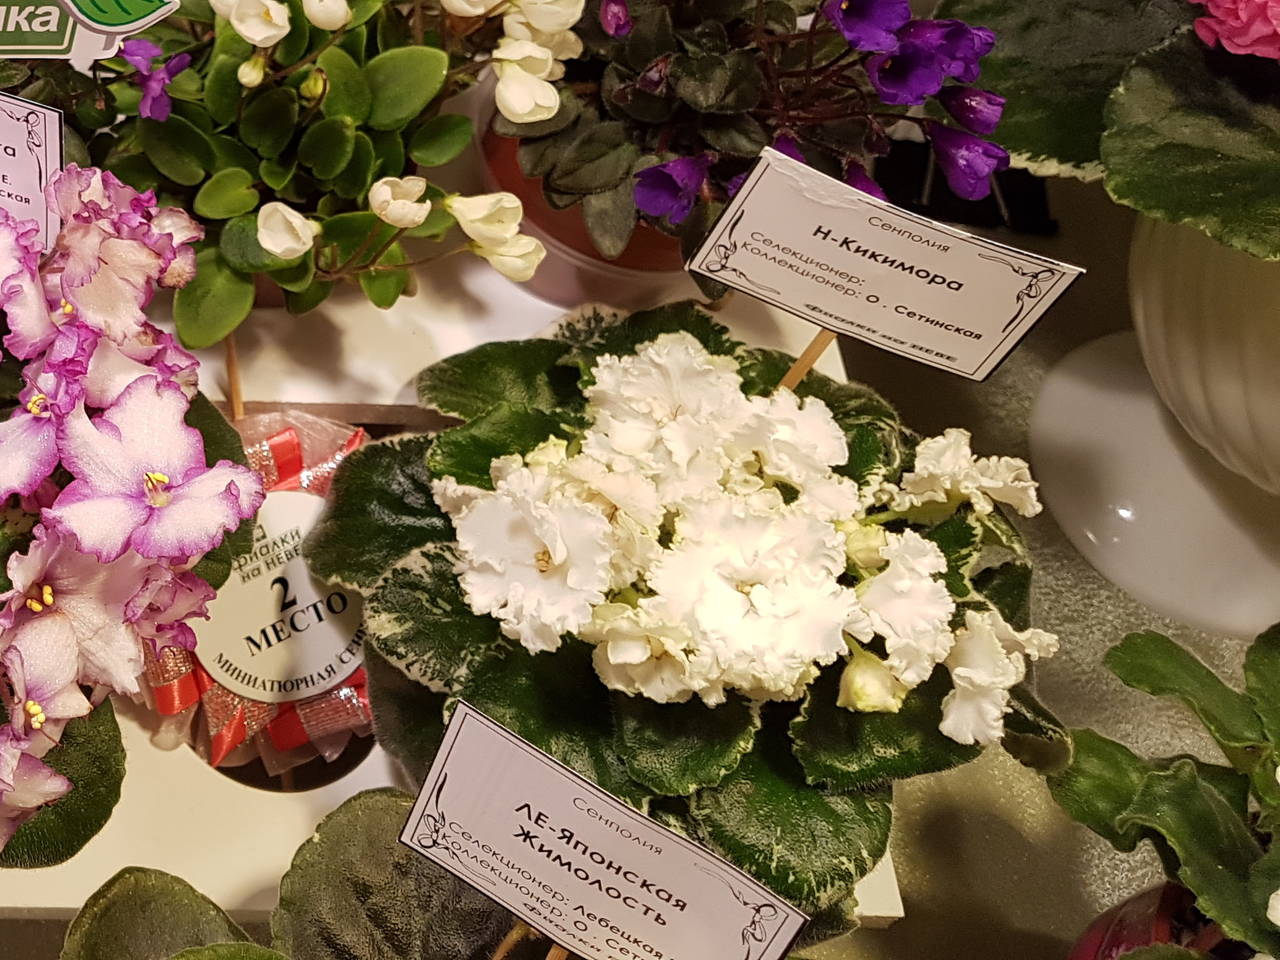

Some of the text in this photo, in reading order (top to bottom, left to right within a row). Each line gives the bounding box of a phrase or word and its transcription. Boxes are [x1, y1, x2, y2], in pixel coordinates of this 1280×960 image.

[750, 231, 866, 287] Селекционер:
[812, 225, 965, 293] Н-Кикимора
[867, 215, 951, 254] Сенполия
[740, 241, 861, 300] Коллекционер:
[894, 304, 983, 341] Сетинская
[244, 592, 348, 657] МЕСТО
[271, 576, 298, 613] 2
[213, 653, 337, 693] МИНИАТЮРНАЯ
[515, 803, 688, 913] ЛЕ-Японская
[572, 796, 664, 856] Сенполия
[440, 830, 566, 923] Коллекционер:
[448, 821, 663, 960] Селекционер: Лебецкая
[514, 825, 669, 928] Жимолость
